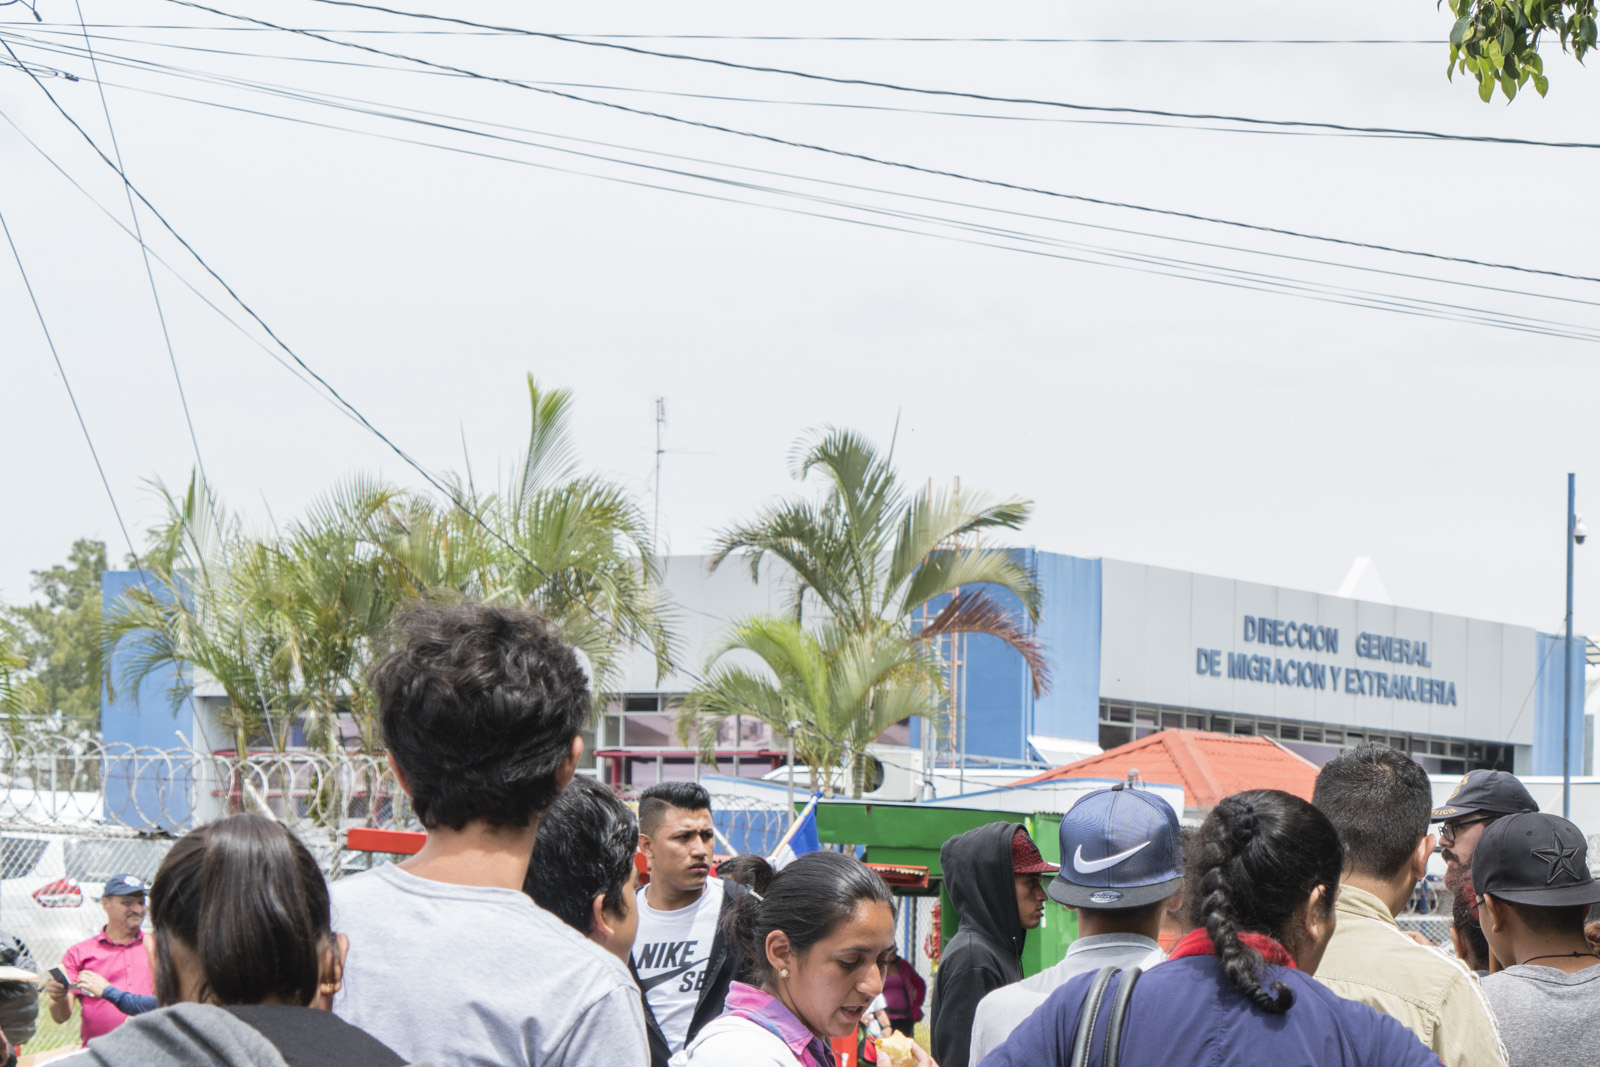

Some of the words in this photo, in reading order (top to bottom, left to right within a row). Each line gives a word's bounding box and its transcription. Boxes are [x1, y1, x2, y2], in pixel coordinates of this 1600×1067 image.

[1244, 615, 1338, 653] DIRECCION
[1356, 631, 1432, 668] GENERAL
[1196, 647, 1222, 677] DE
[1227, 651, 1326, 691] MIGRACION
[1330, 666, 1341, 691] Y
[1345, 667, 1457, 707] EXTRANJERIA
[636, 940, 699, 970] NIKE
